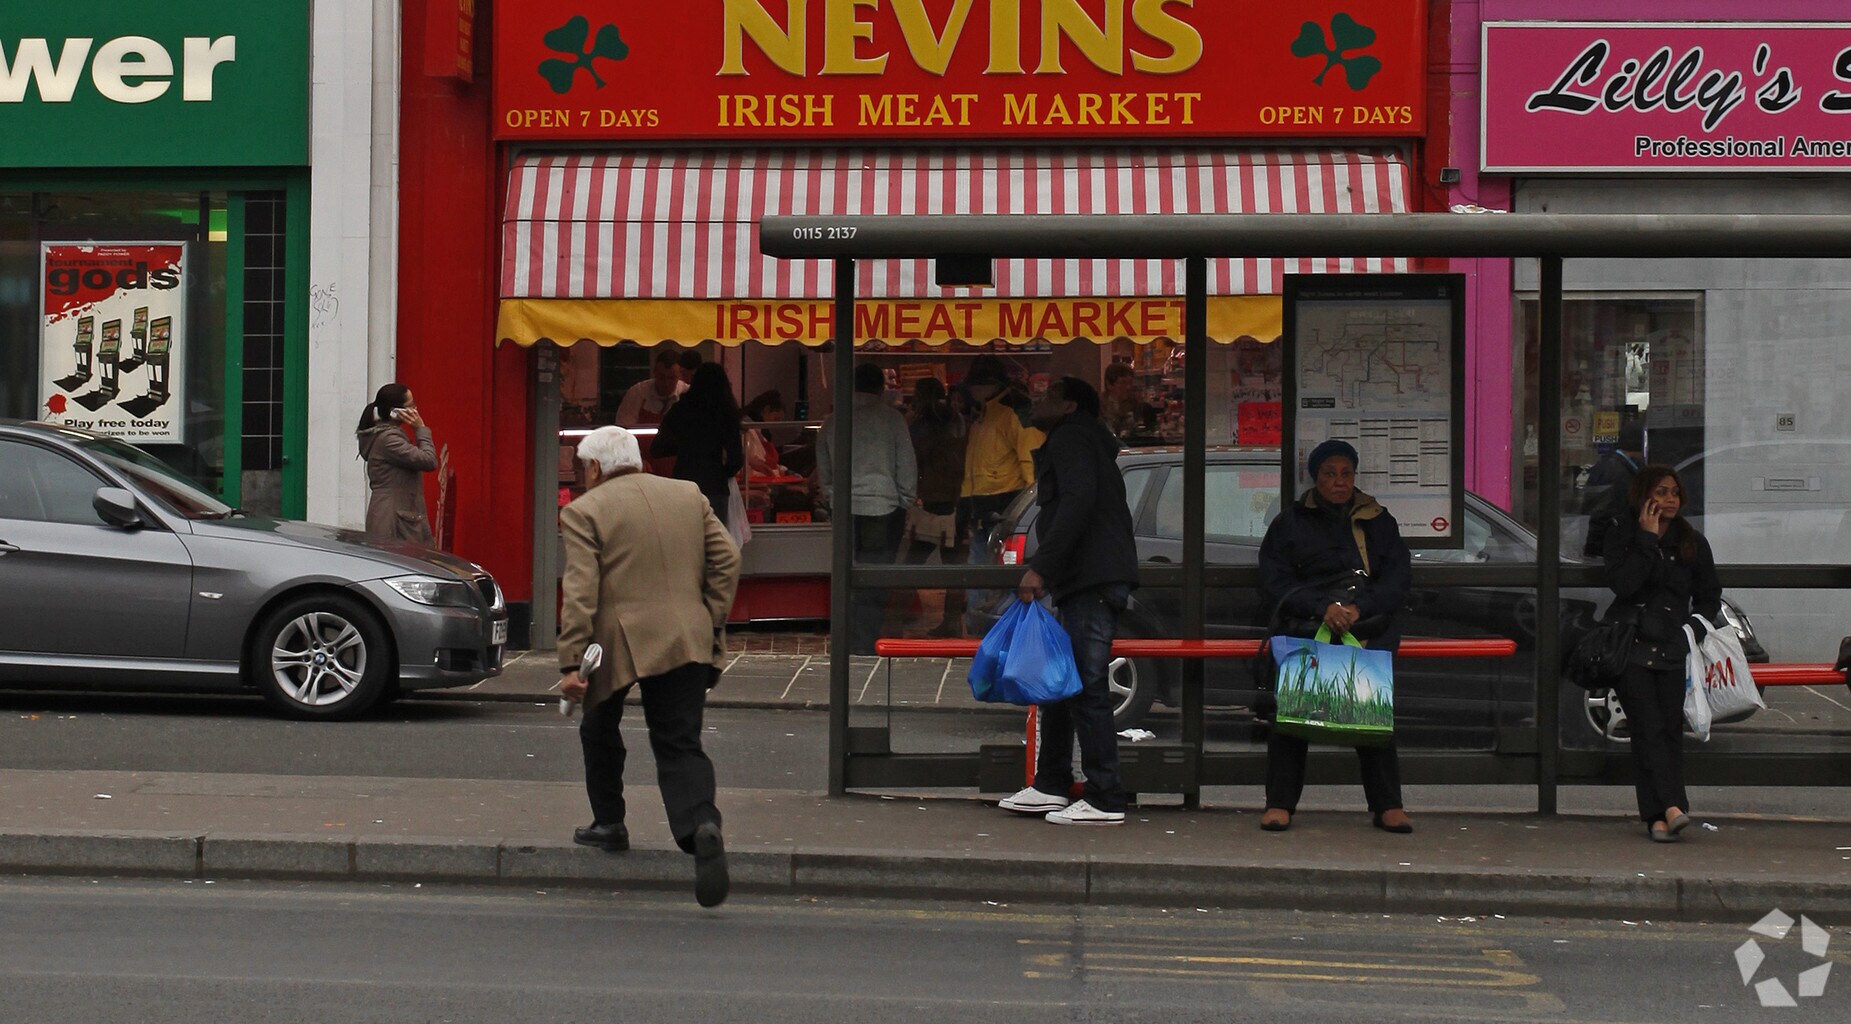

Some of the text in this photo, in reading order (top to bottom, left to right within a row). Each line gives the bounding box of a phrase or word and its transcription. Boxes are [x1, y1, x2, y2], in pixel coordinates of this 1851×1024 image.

[0, 35, 236, 104] wer
[1525, 38, 1802, 133] Lilly's
[506, 109, 659, 128] OPEN 7 DAYS
[717, 92, 1202, 127] IRISH MEAT MARKET
[1259, 105, 1413, 125] OPEN 7 DAYS
[1634, 135, 1785, 158] Professional
[792, 225, 858, 240] 0115 2137
[50, 257, 133, 267] tournament
[49, 261, 180, 295] gods
[716, 303, 836, 340] IRISH
[855, 302, 982, 339] MEAT
[64, 419, 170, 429] Play free today
[1778, 417, 1794, 427] 85
[1595, 434, 1617, 443] PUSH
